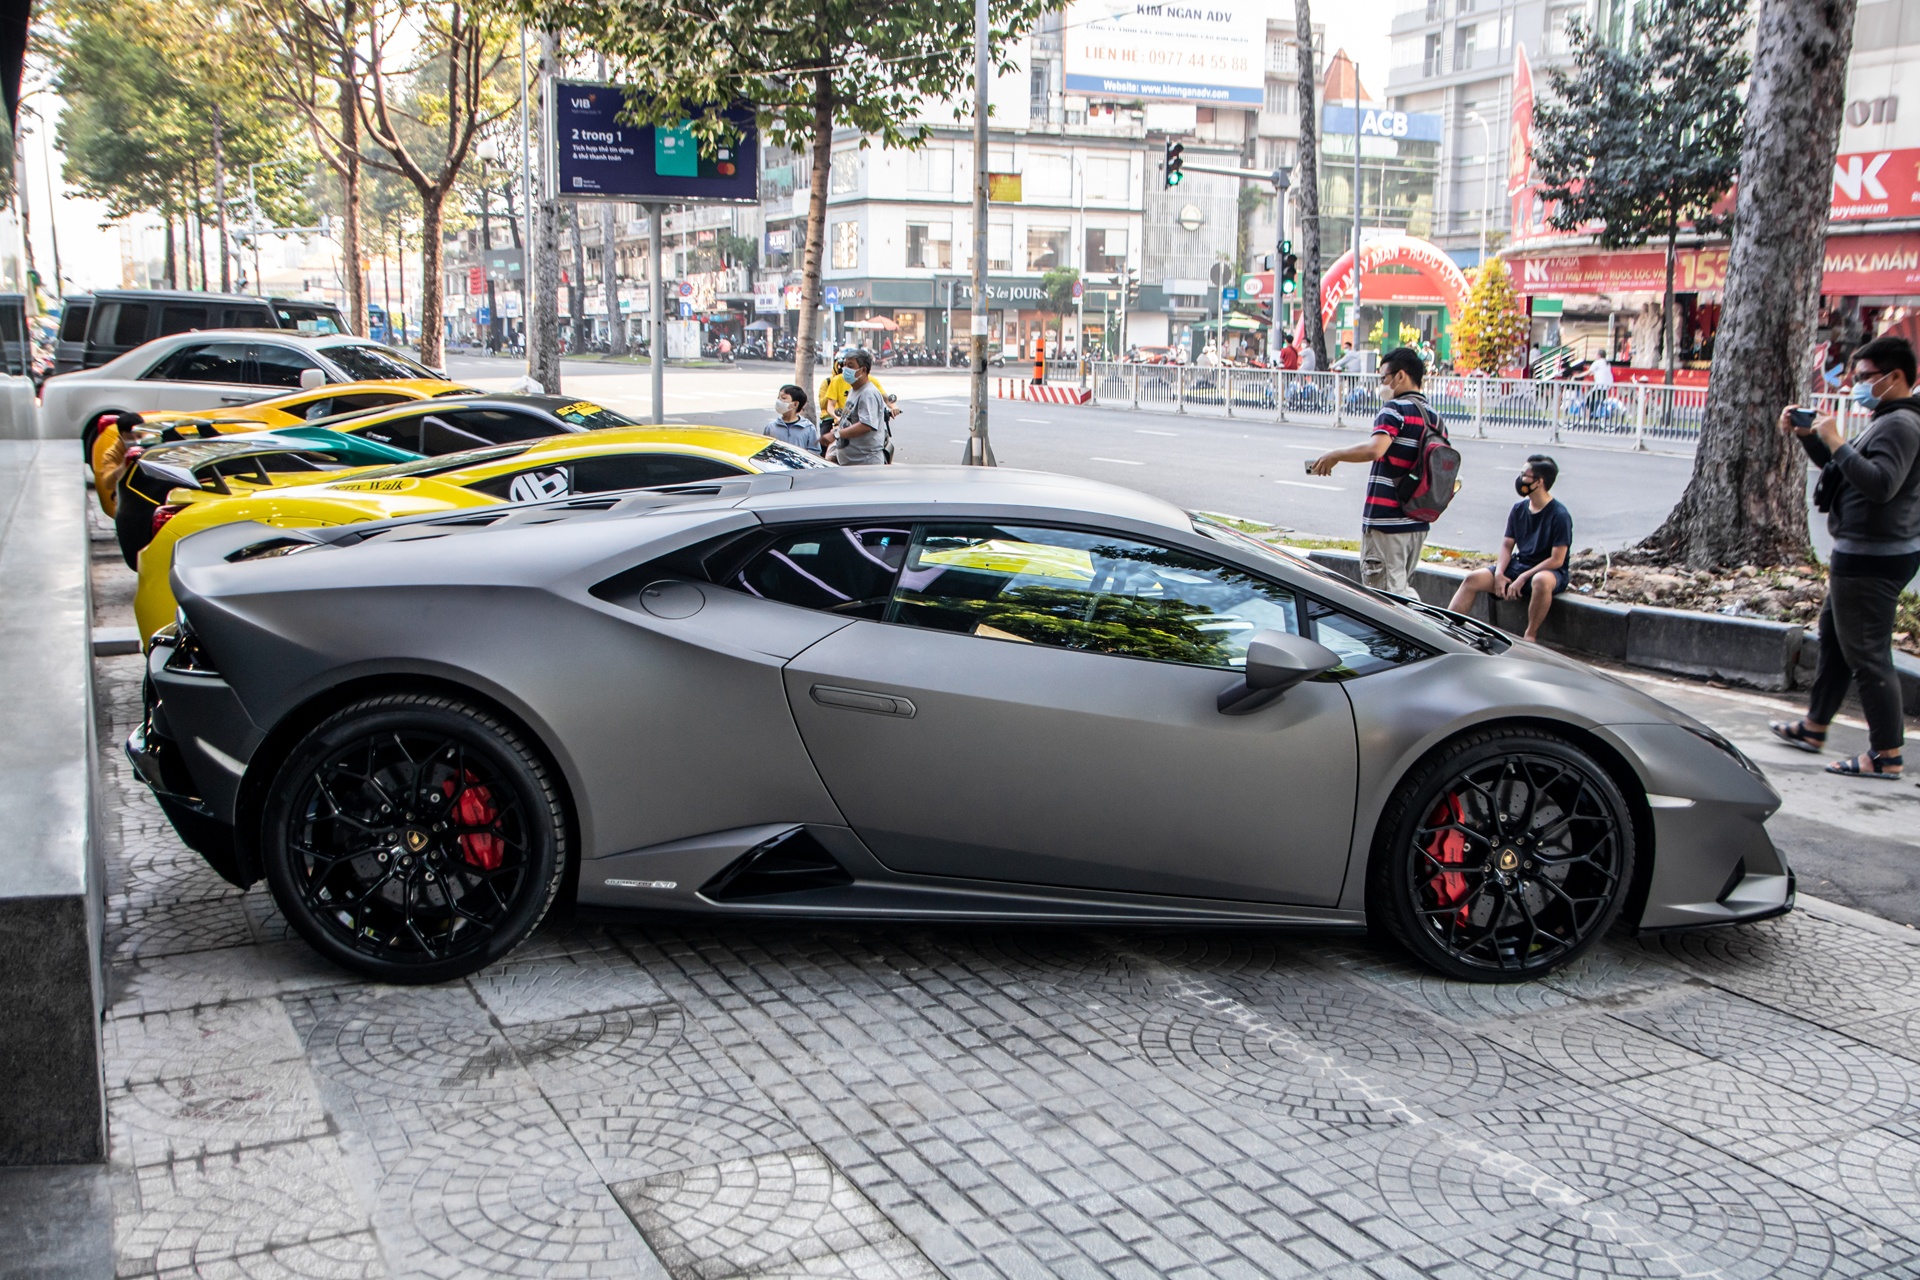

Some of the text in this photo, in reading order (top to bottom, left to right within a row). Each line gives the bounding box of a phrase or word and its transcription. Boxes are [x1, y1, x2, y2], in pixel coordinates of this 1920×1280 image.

[1136, 4, 1162, 17] KIM
[1167, 7, 1202, 20] NGAN
[1206, 10, 1232, 22] ADV
[1149, 50, 1183, 66] 0977
[1188, 53, 1205, 68] 44
[1210, 54, 1227, 70] 55
[1231, 57, 1248, 71] 88
[1103, 80, 1229, 99] Website: www.kimnganadv.com
[571, 98, 591, 109] VIB
[1360, 110, 1408, 137] ACB
[572, 128, 622, 145] 2 trong 1
[1830, 152, 1892, 201] NK
[1524, 259, 1551, 282] NK
[1823, 253, 1867, 272] MAY
[962, 284, 995, 299] TS
[996, 286, 1009, 299] les
[369, 480, 406, 491] Walk
